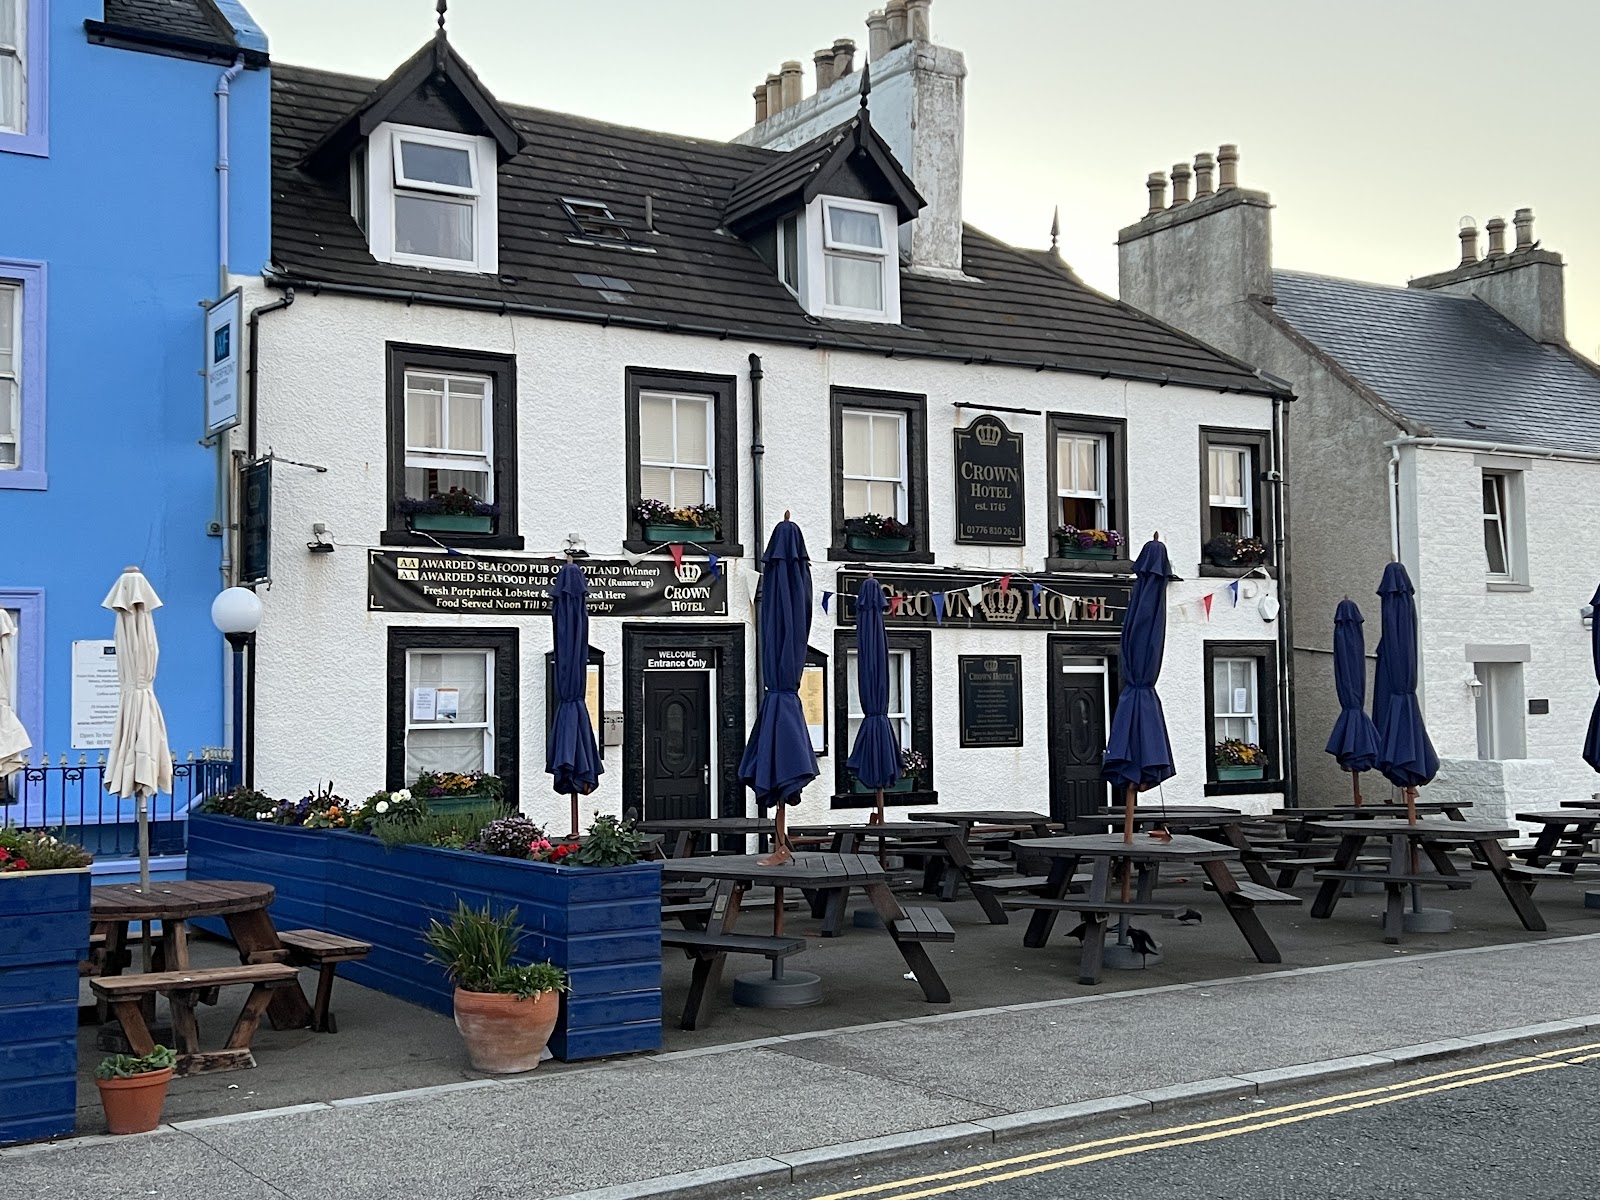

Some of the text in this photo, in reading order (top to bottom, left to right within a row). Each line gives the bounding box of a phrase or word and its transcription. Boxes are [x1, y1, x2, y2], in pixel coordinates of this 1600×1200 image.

[961, 461, 1018, 482] CROWN
[970, 483, 1012, 499] HOTEL
[974, 503, 988, 511] est.
[966, 525, 1016, 536] 01776 810 261
[420, 559, 476, 571] AWARDED
[477, 561, 528, 573] SEAFOOD
[529, 564, 549, 574] PUB
[622, 566, 660, 576] (Winner)
[420, 571, 476, 582] AWARDED
[477, 573, 527, 585] SEAFOOD
[528, 576, 549, 586] PUB
[608, 578, 639, 588] (Runner
[641, 579, 654, 589] up)
[423, 585, 449, 596] Fresh
[450, 586, 503, 598] Portpatrick
[505, 588, 540, 598] Lobster
[540, 589, 549, 598] &
[604, 591, 626, 600] Here
[664, 585, 710, 600] CROWN
[436, 597, 460, 608] Food
[461, 598, 494, 609] Served
[495, 599, 521, 609] Noon
[523, 600, 540, 609] Till
[586, 601, 614, 613] eryday
[671, 600, 706, 612] HOTEL
[648, 658, 707, 669] Entrance Only
[969, 673, 1014, 681] CROWN HOTEL
